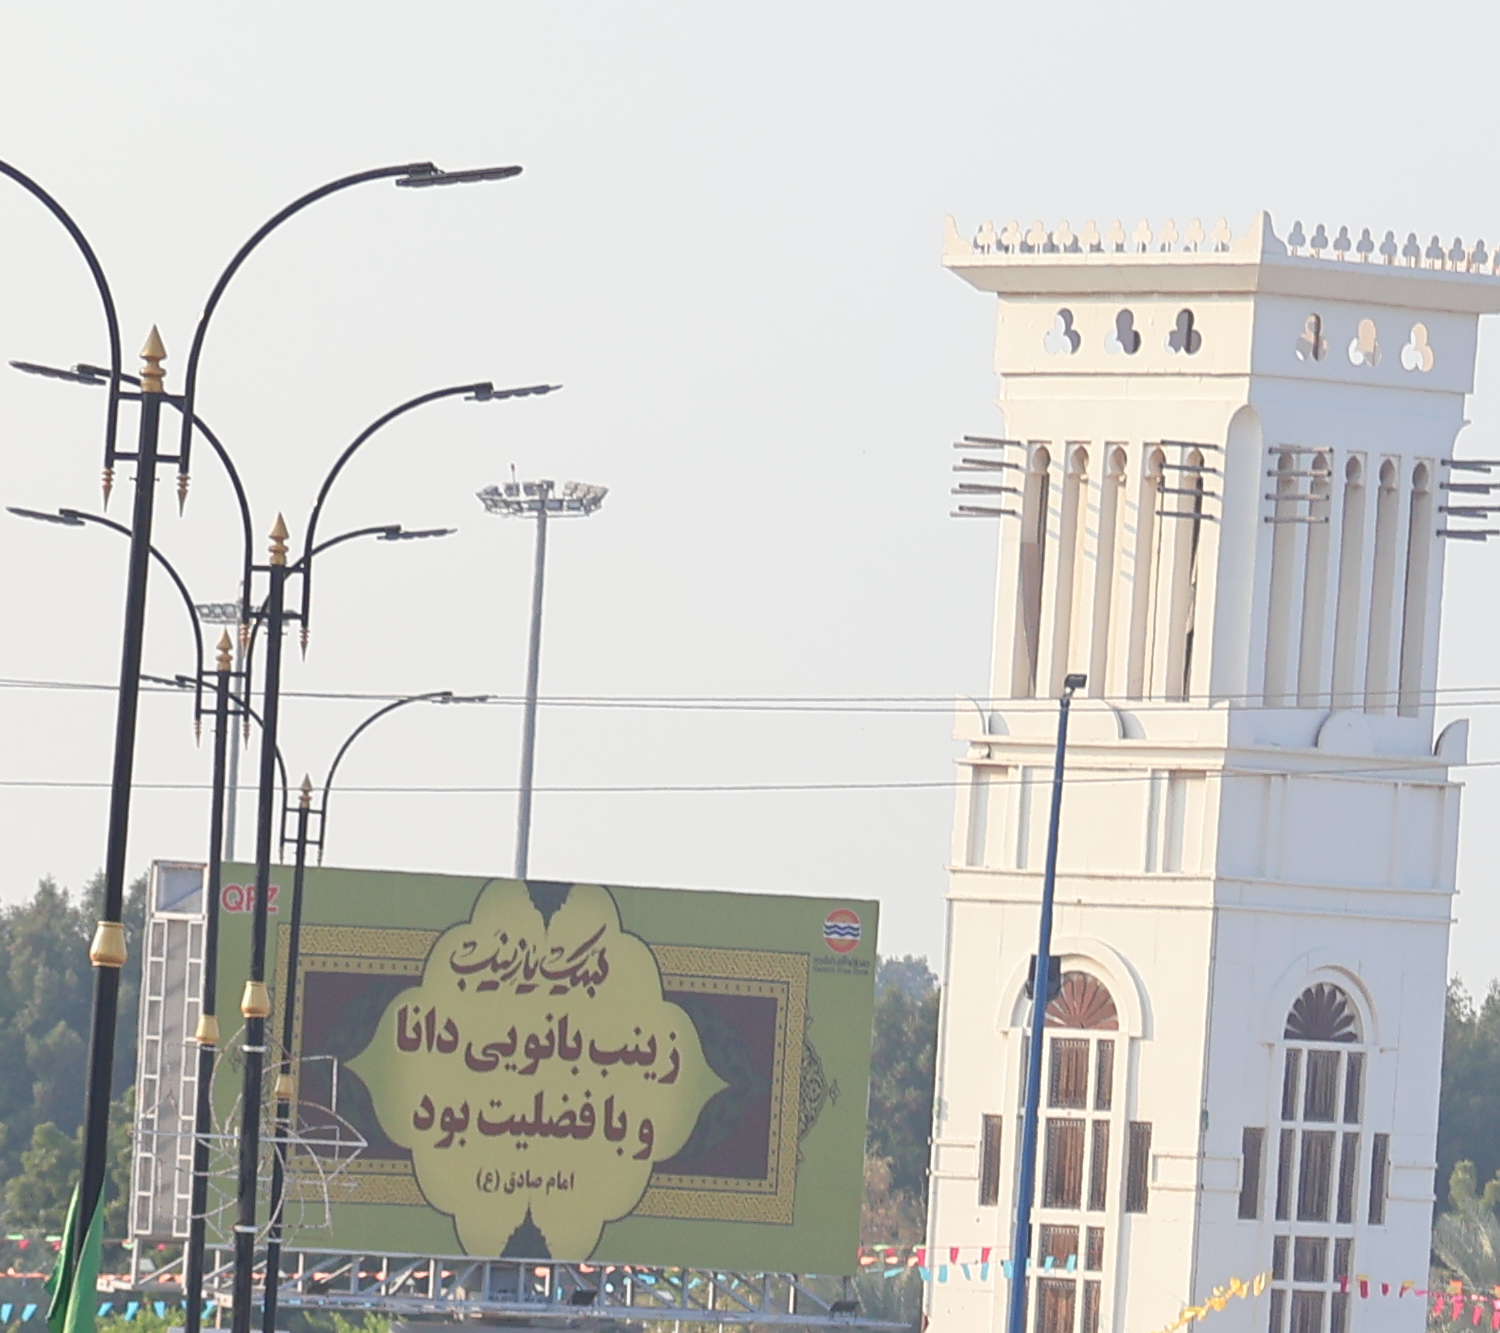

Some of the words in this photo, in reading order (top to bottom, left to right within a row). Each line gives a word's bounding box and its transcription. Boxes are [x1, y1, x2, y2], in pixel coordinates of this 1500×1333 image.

[396, 1004, 460, 1054] دانا
[465, 1012, 583, 1076] بانویی
[588, 1025, 680, 1085] زینب
[412, 1094, 471, 1149] بود
[603, 1094, 628, 1157] با
[632, 1117, 655, 1161] و
[476, 1167, 501, 1192] (ع)
[503, 1169, 543, 1194] صادق
[545, 1171, 575, 1194] امام
